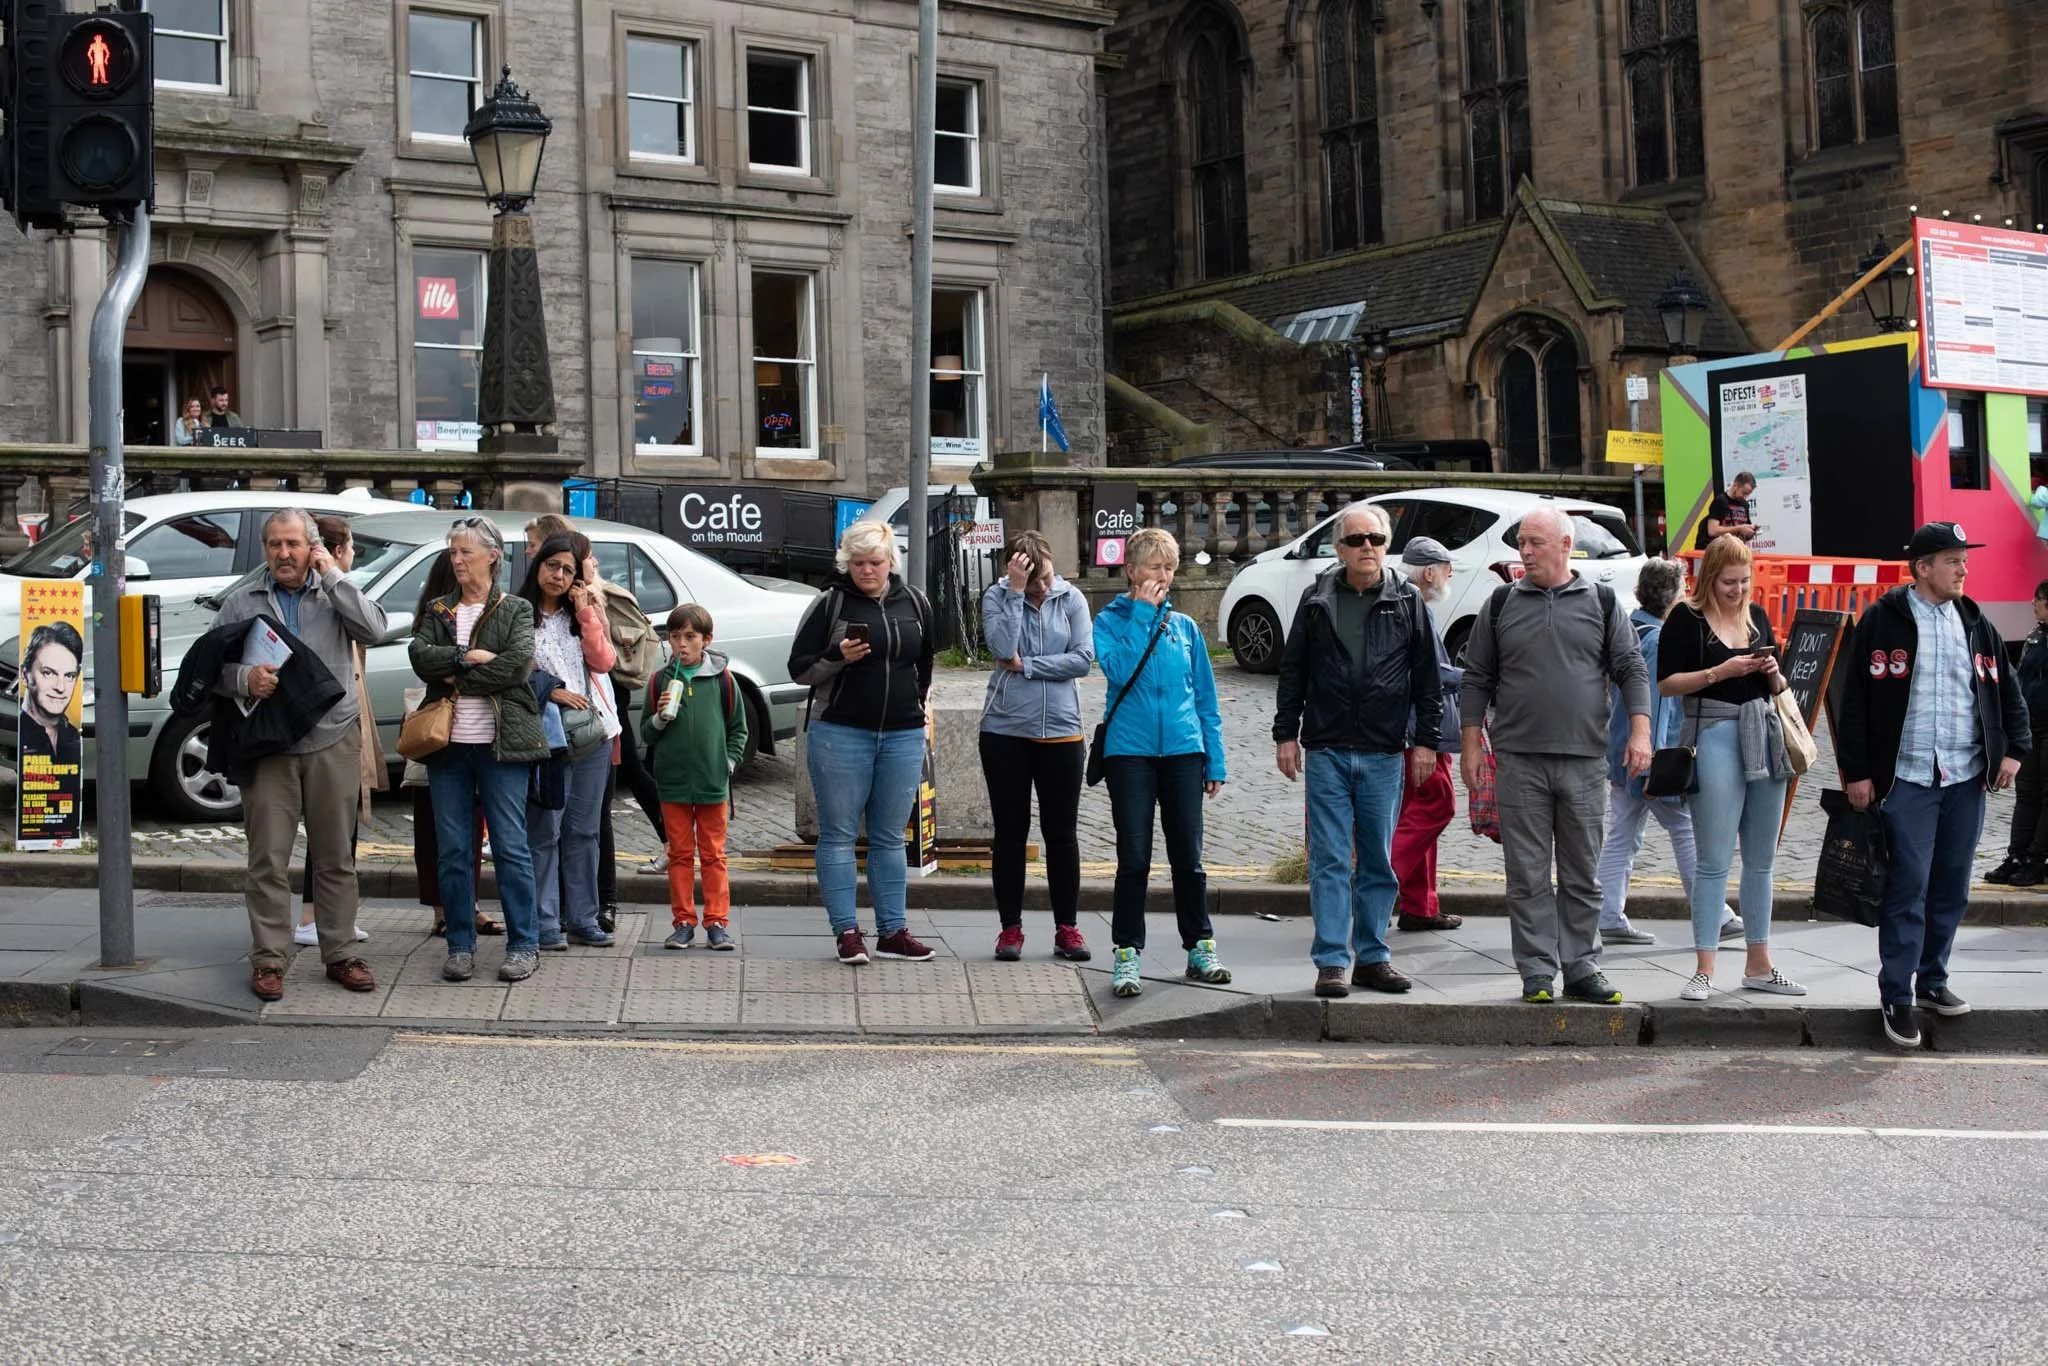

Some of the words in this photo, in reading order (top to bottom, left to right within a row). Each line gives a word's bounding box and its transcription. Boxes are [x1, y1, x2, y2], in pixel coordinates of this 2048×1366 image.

[423, 283, 456, 315] illy
[764, 415, 793, 427] OPEN
[213, 433, 247, 448] BEER
[1612, 436, 1625, 445] NO
[680, 493, 762, 530] Cafe
[1094, 509, 1134, 529] Cafe
[691, 532, 705, 542] on
[707, 531, 723, 542] the
[965, 534, 1002, 545] PARKING
[1790, 660, 1818, 681] KEEP
[23, 755, 53, 765] PAUL
[23, 764, 79, 775] MERTON'S
